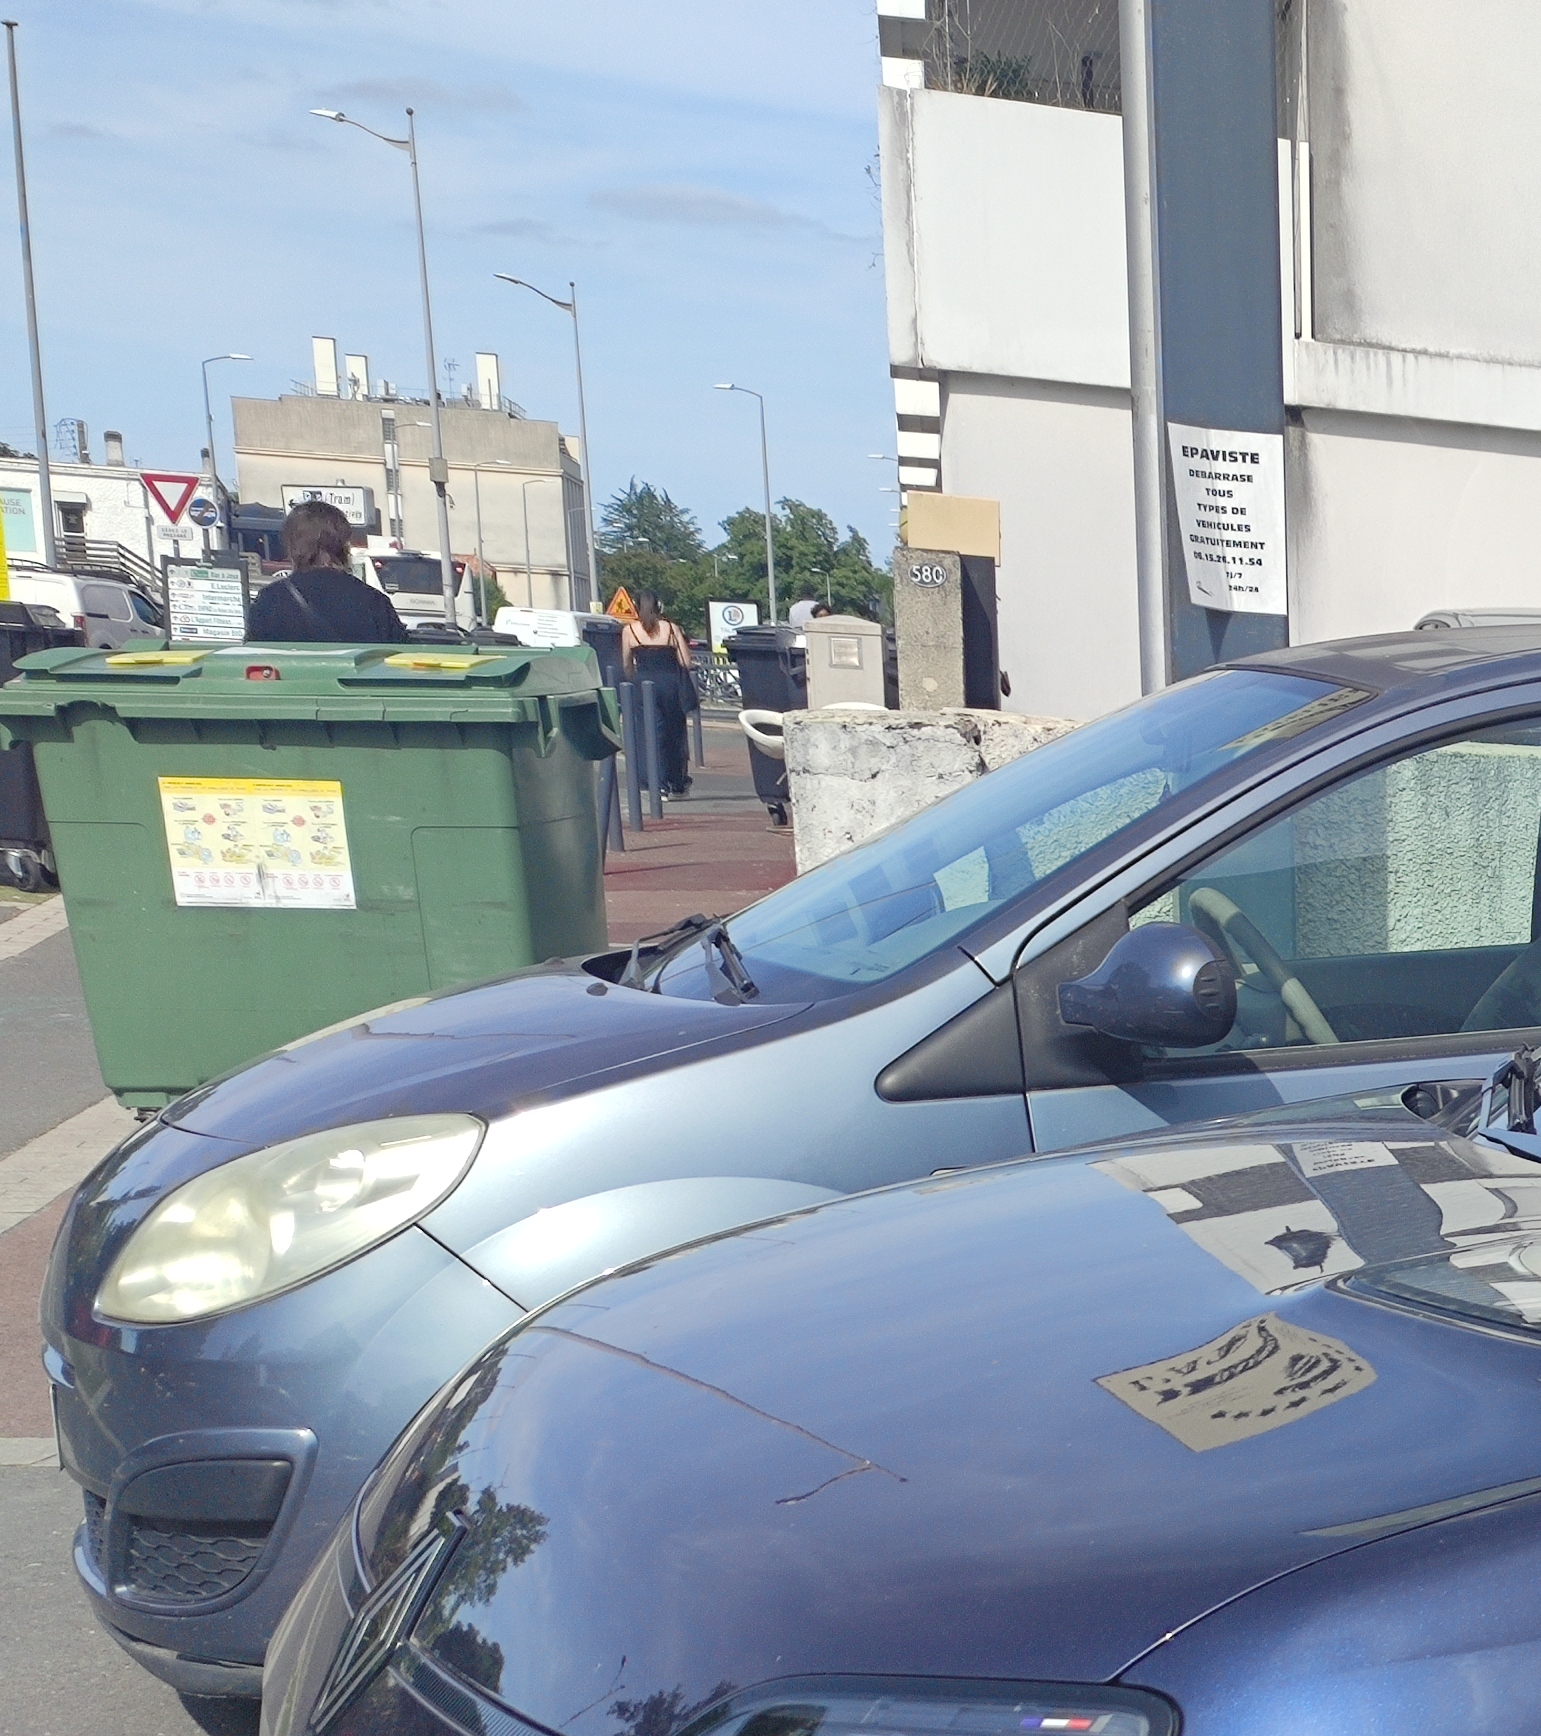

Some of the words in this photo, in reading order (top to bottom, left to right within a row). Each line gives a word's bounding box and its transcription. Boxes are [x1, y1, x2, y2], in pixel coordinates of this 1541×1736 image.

[1181, 445, 1260, 465] EPAVISTE
[1188, 468, 1254, 483] DEBARRASE
[1205, 487, 1234, 499] TOUS
[1197, 503, 1228, 515] TYPES
[1231, 506, 1247, 516] DE
[1196, 519, 1252, 532] VEHICULES
[1189, 534, 1266, 550] GRATUITEMENT
